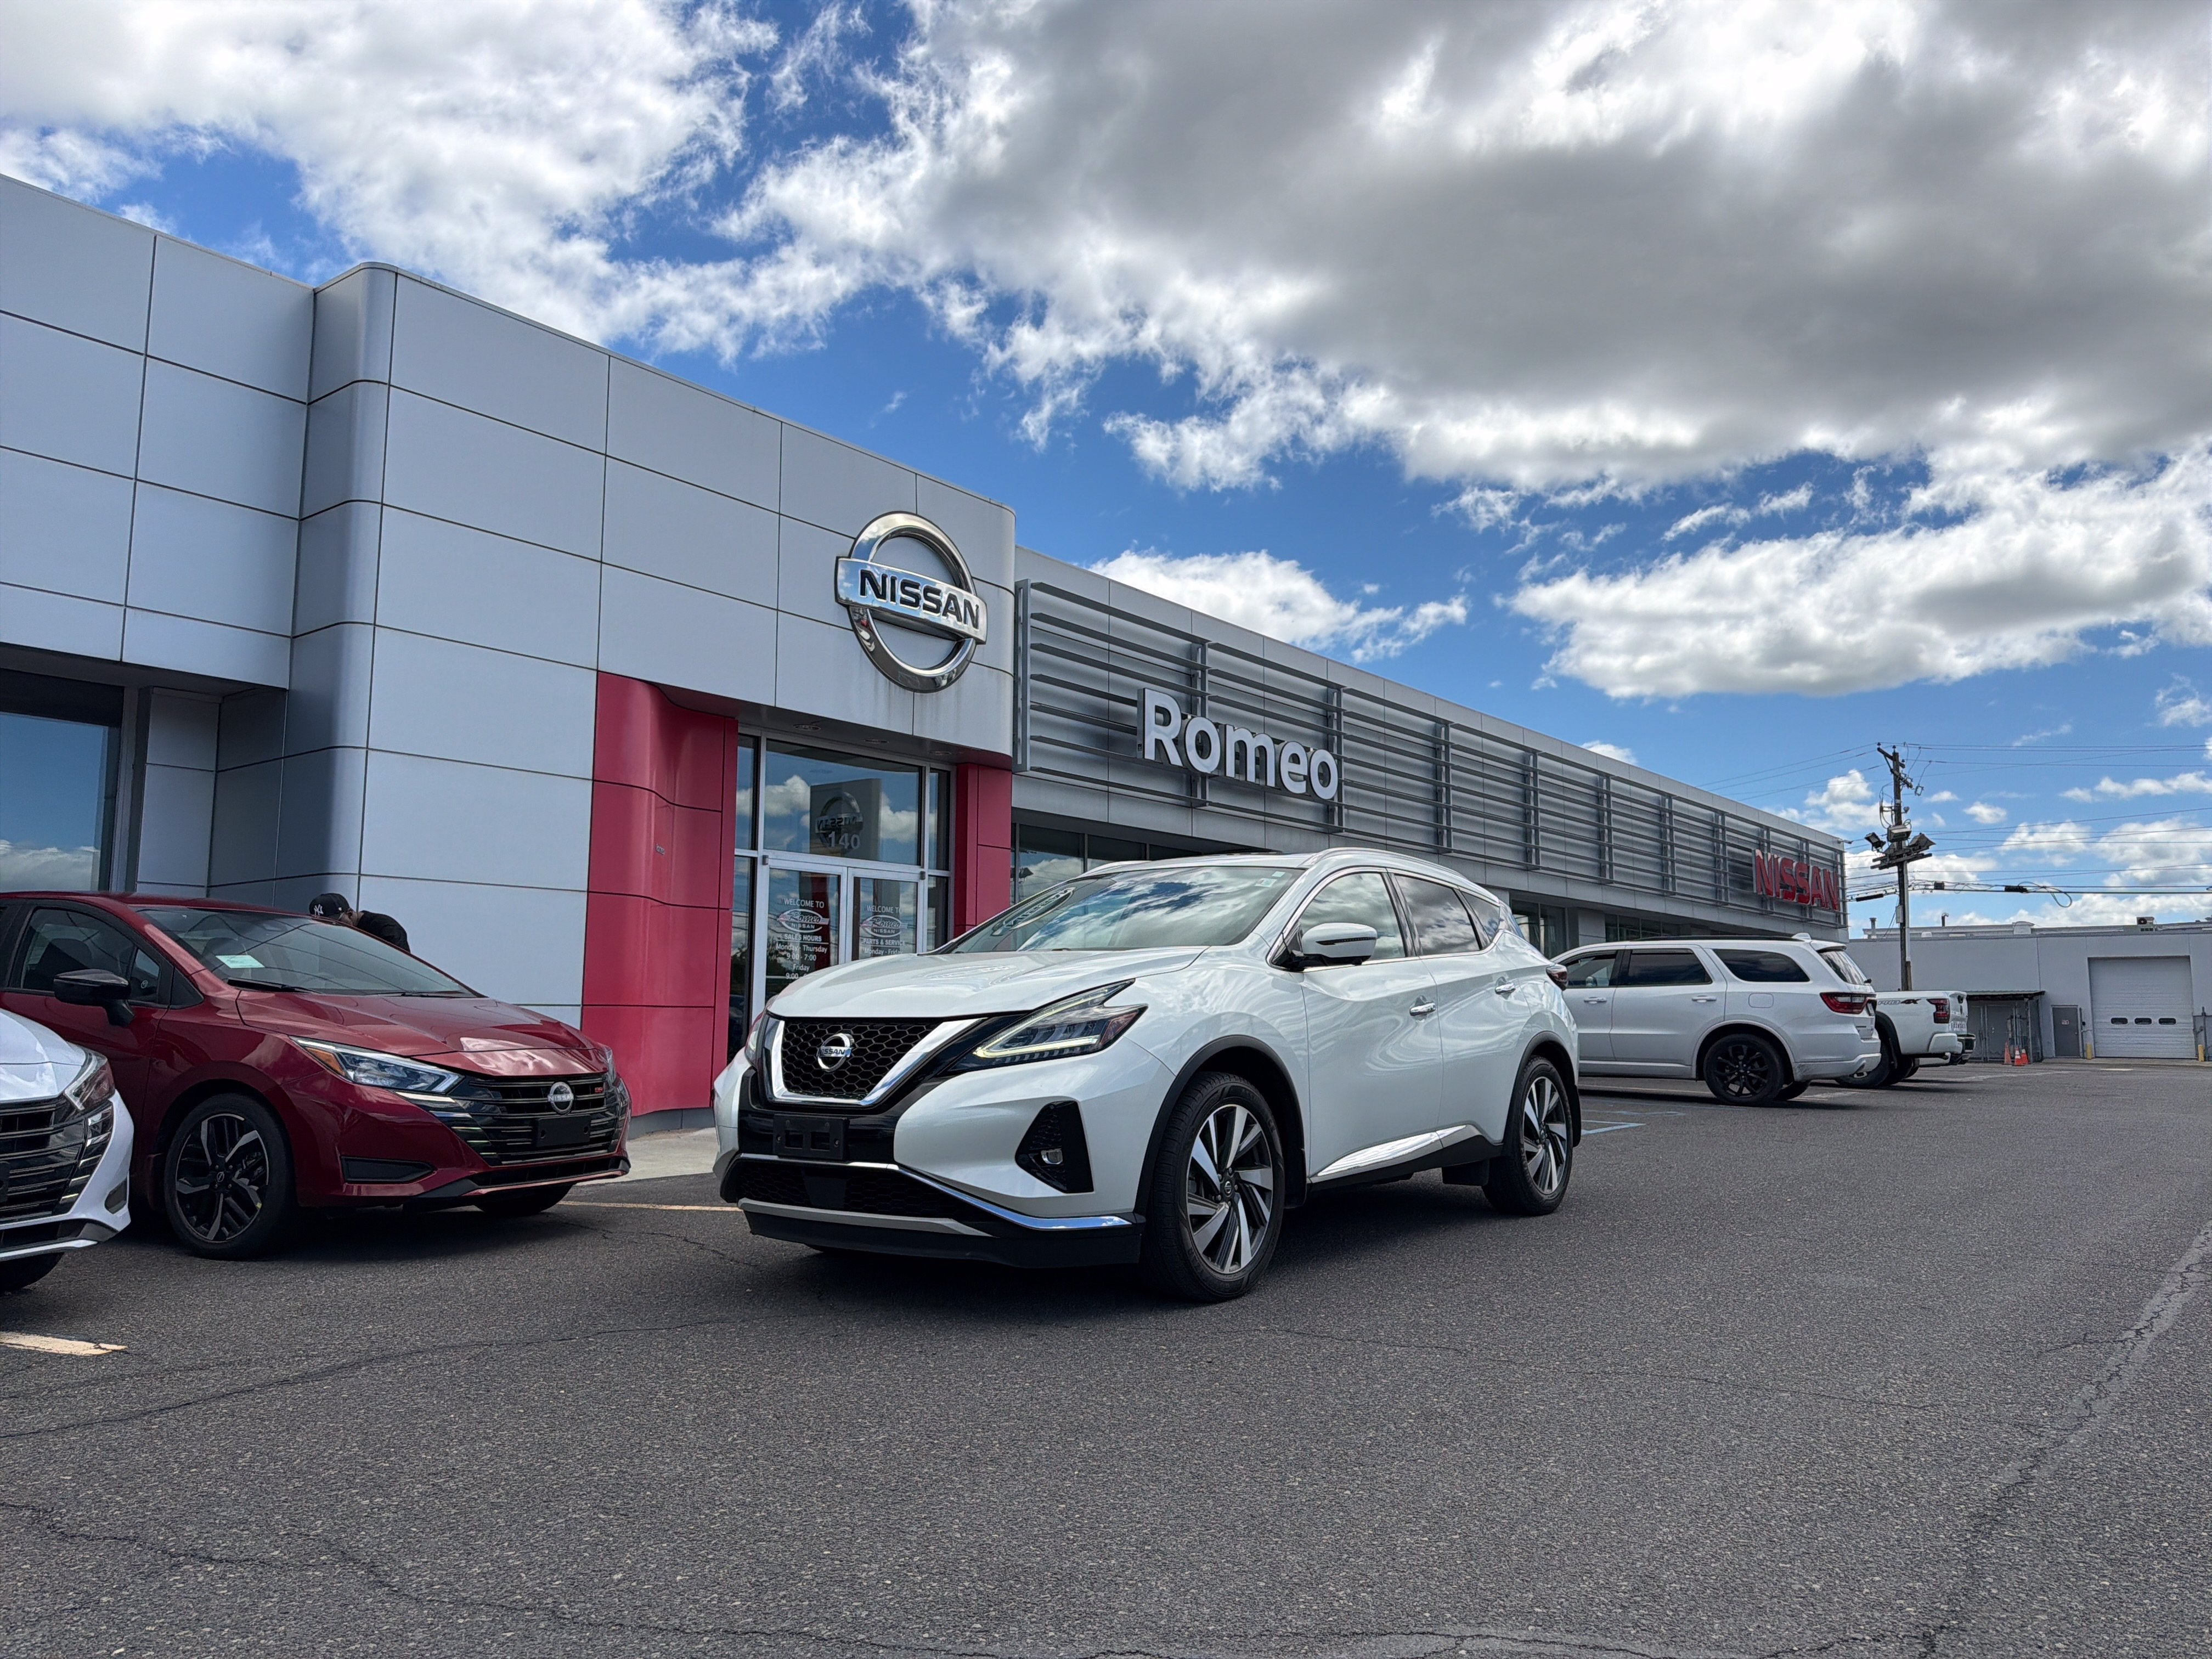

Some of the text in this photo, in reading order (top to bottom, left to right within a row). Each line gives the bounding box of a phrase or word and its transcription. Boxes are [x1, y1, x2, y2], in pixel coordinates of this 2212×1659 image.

[859, 569, 980, 631] NISSAN
[1137, 688, 1338, 799] Romeo
[828, 831, 861, 849] 140
[1752, 849, 1839, 912] NISSAN
[784, 898, 814, 908] WELCOME
[866, 905, 894, 913] WELCOME
[787, 910, 821, 923] Romeo
[870, 917, 900, 928] Romeo
[776, 943, 799, 951] Monday
[803, 944, 828, 953] Thursday
